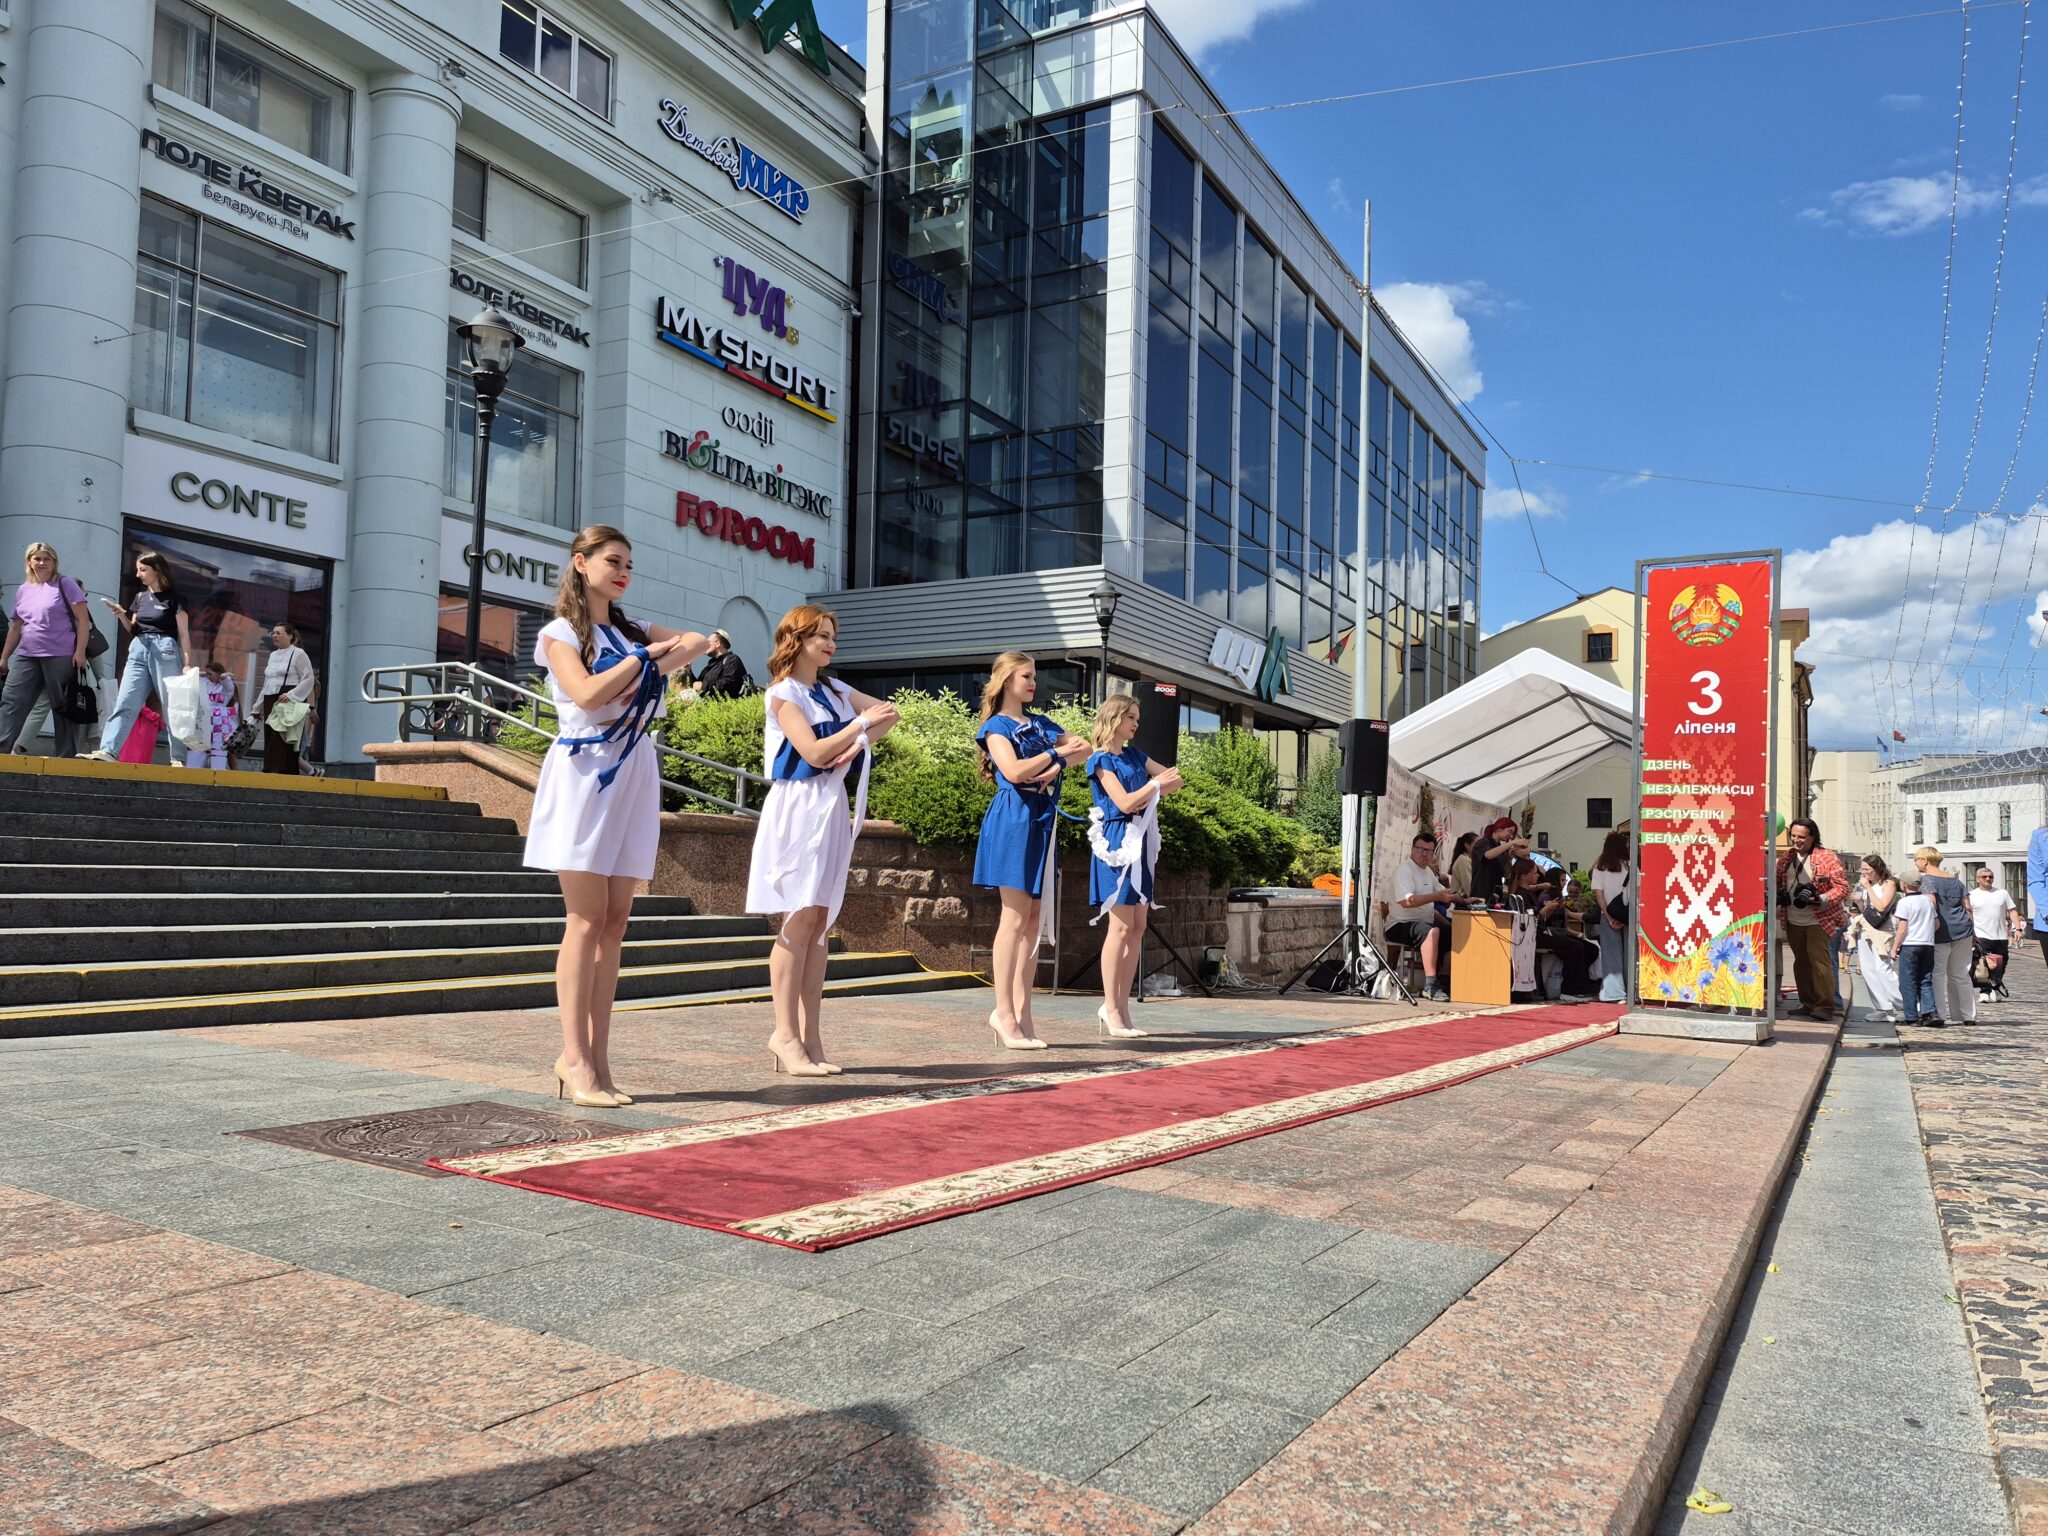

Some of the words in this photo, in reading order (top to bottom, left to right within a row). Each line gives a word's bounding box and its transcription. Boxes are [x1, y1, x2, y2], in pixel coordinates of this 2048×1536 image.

[657, 98, 740, 177] Детский
[734, 139, 811, 223] МИР
[141, 128, 232, 186] ПОЛЕ
[239, 166, 356, 241] КВЕТАК
[203, 184, 277, 226] Беларускі
[508, 290, 590, 347] КВЕТАК
[659, 296, 837, 409] MYSPORT
[722, 406, 775, 447] oodji
[171, 471, 308, 529] CONTE
[676, 491, 815, 569] FOROOM
[1208, 626, 1293, 703] ЦУМ
[1687, 670, 1723, 716] 3
[1674, 720, 1736, 735] ліпеня
[1646, 760, 1692, 771] ДЗЕНЬ
[1646, 784, 1755, 796] НЕЗАЛЕЖНАСЦІ
[1645, 809, 1725, 820] РЭСПУБЛІКІ
[1645, 833, 1718, 845] БЕЛАРУСЬ
